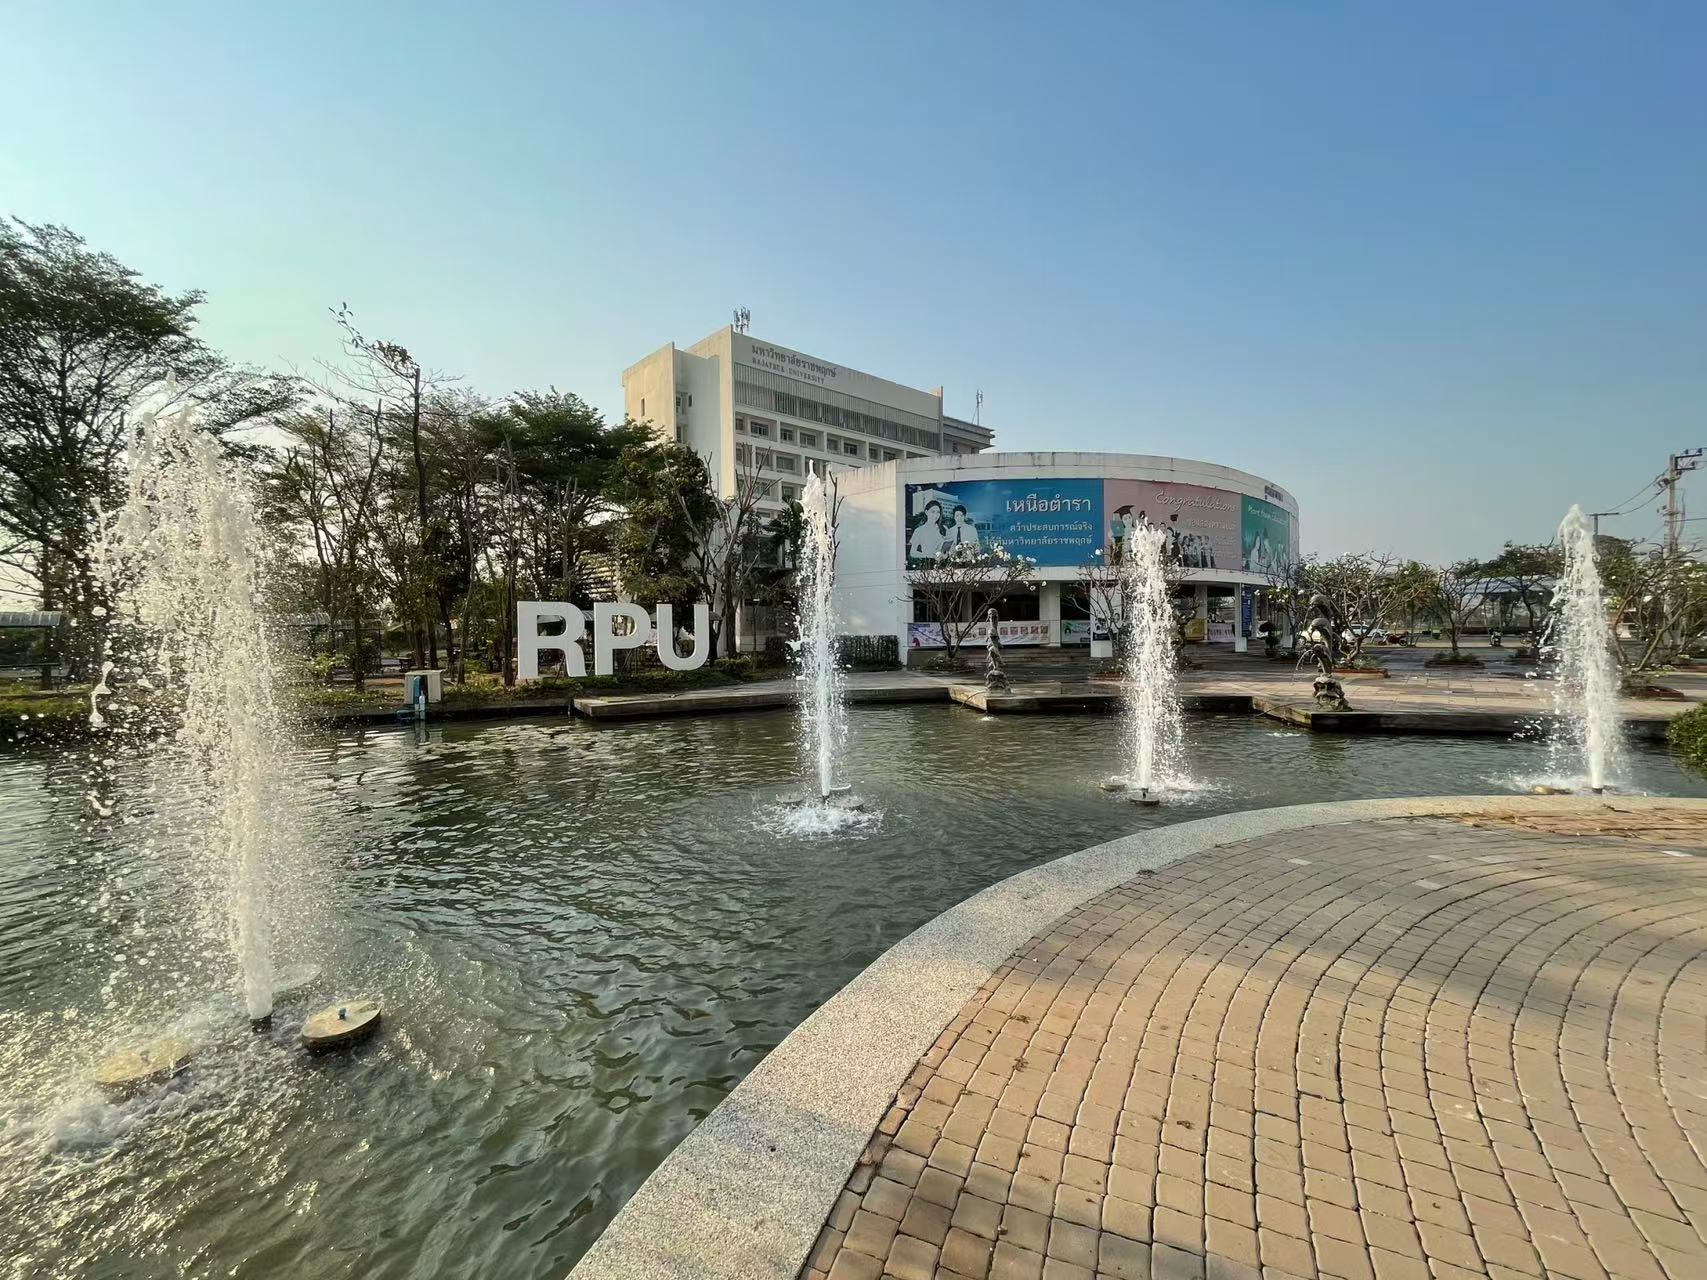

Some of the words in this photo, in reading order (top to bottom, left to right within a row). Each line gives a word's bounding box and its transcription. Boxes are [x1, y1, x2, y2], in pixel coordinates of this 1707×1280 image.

[788, 367, 824, 384] UNIVERSITY
[1006, 493, 1091, 512] เหนือตำรา
[1155, 489, 1236, 512] Congratulations
[517, 601, 709, 679] RPU
